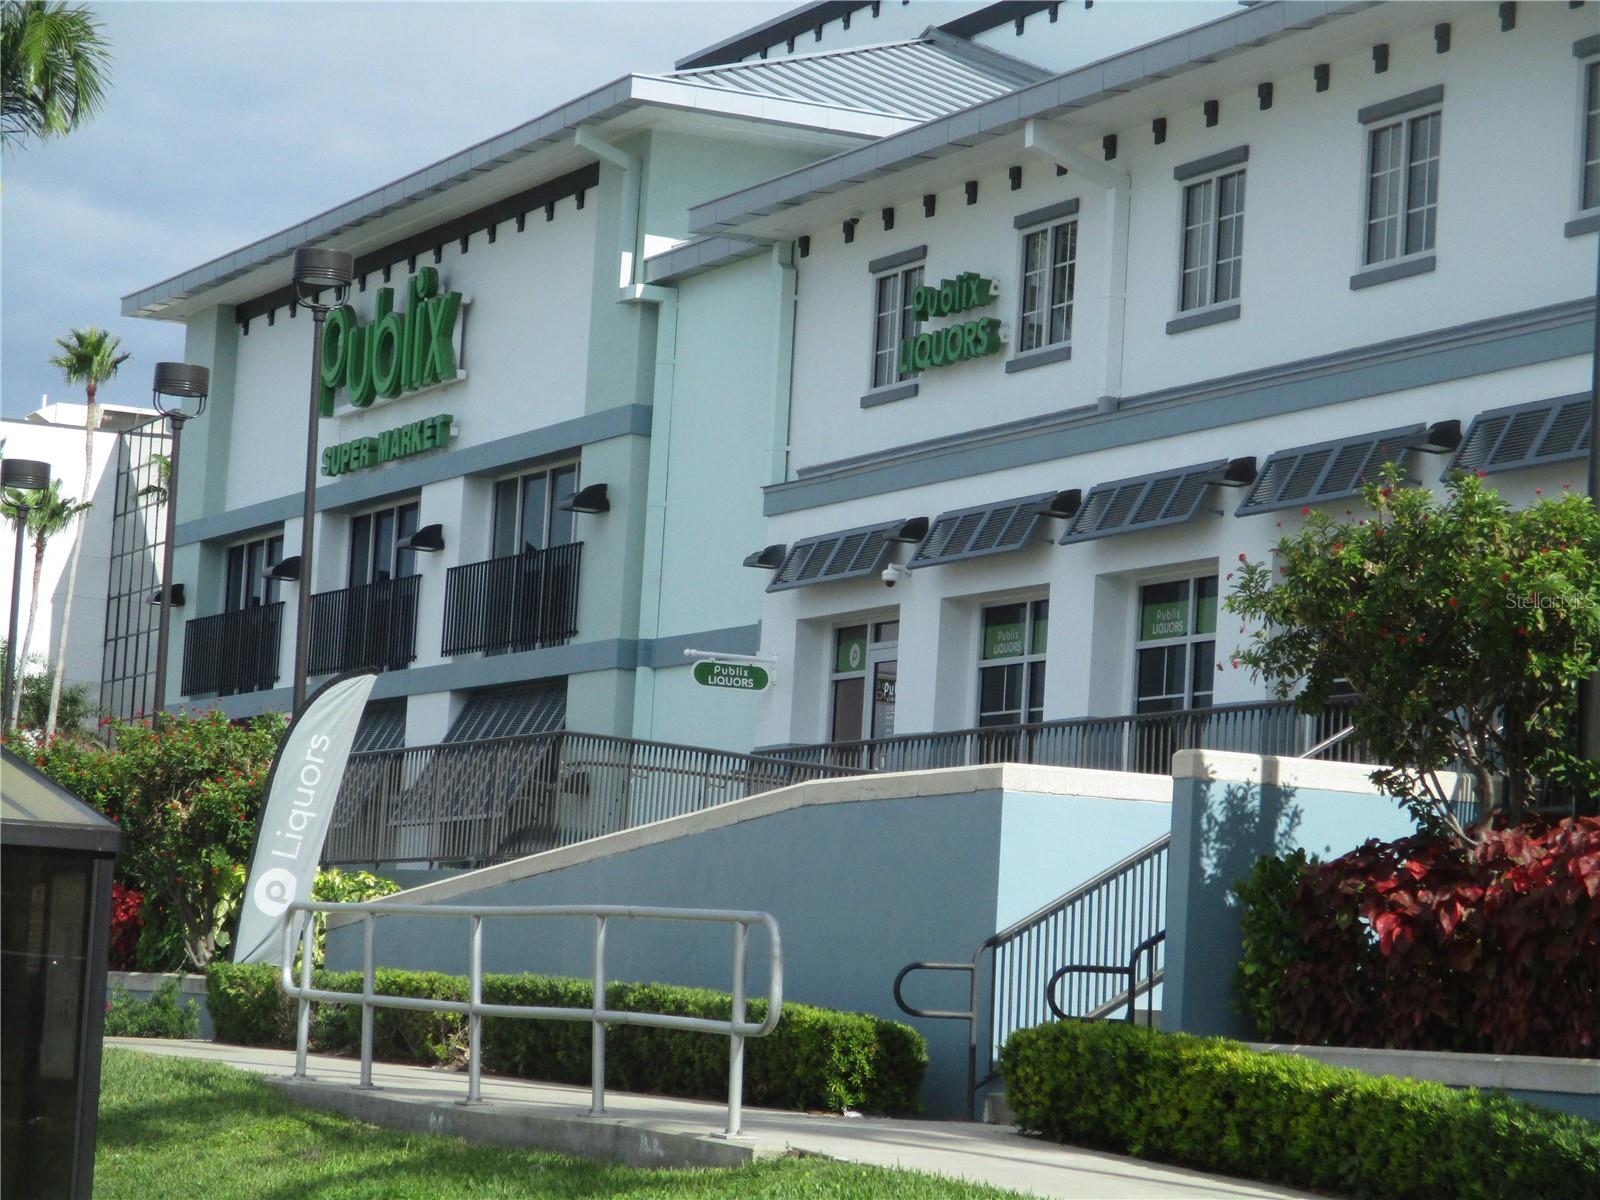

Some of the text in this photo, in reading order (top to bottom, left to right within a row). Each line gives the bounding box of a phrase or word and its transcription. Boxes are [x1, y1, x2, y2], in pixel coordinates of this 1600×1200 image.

[913, 272, 992, 321] Publix
[320, 267, 462, 418] Publix
[899, 317, 1001, 373] LIQUORS
[321, 414, 453, 476] SUPER MARKET
[1152, 620, 1184, 635] LIQUORS
[708, 675, 754, 688] LIQUORS
[714, 665, 749, 677] Publix
[271, 733, 330, 860] Liquors
